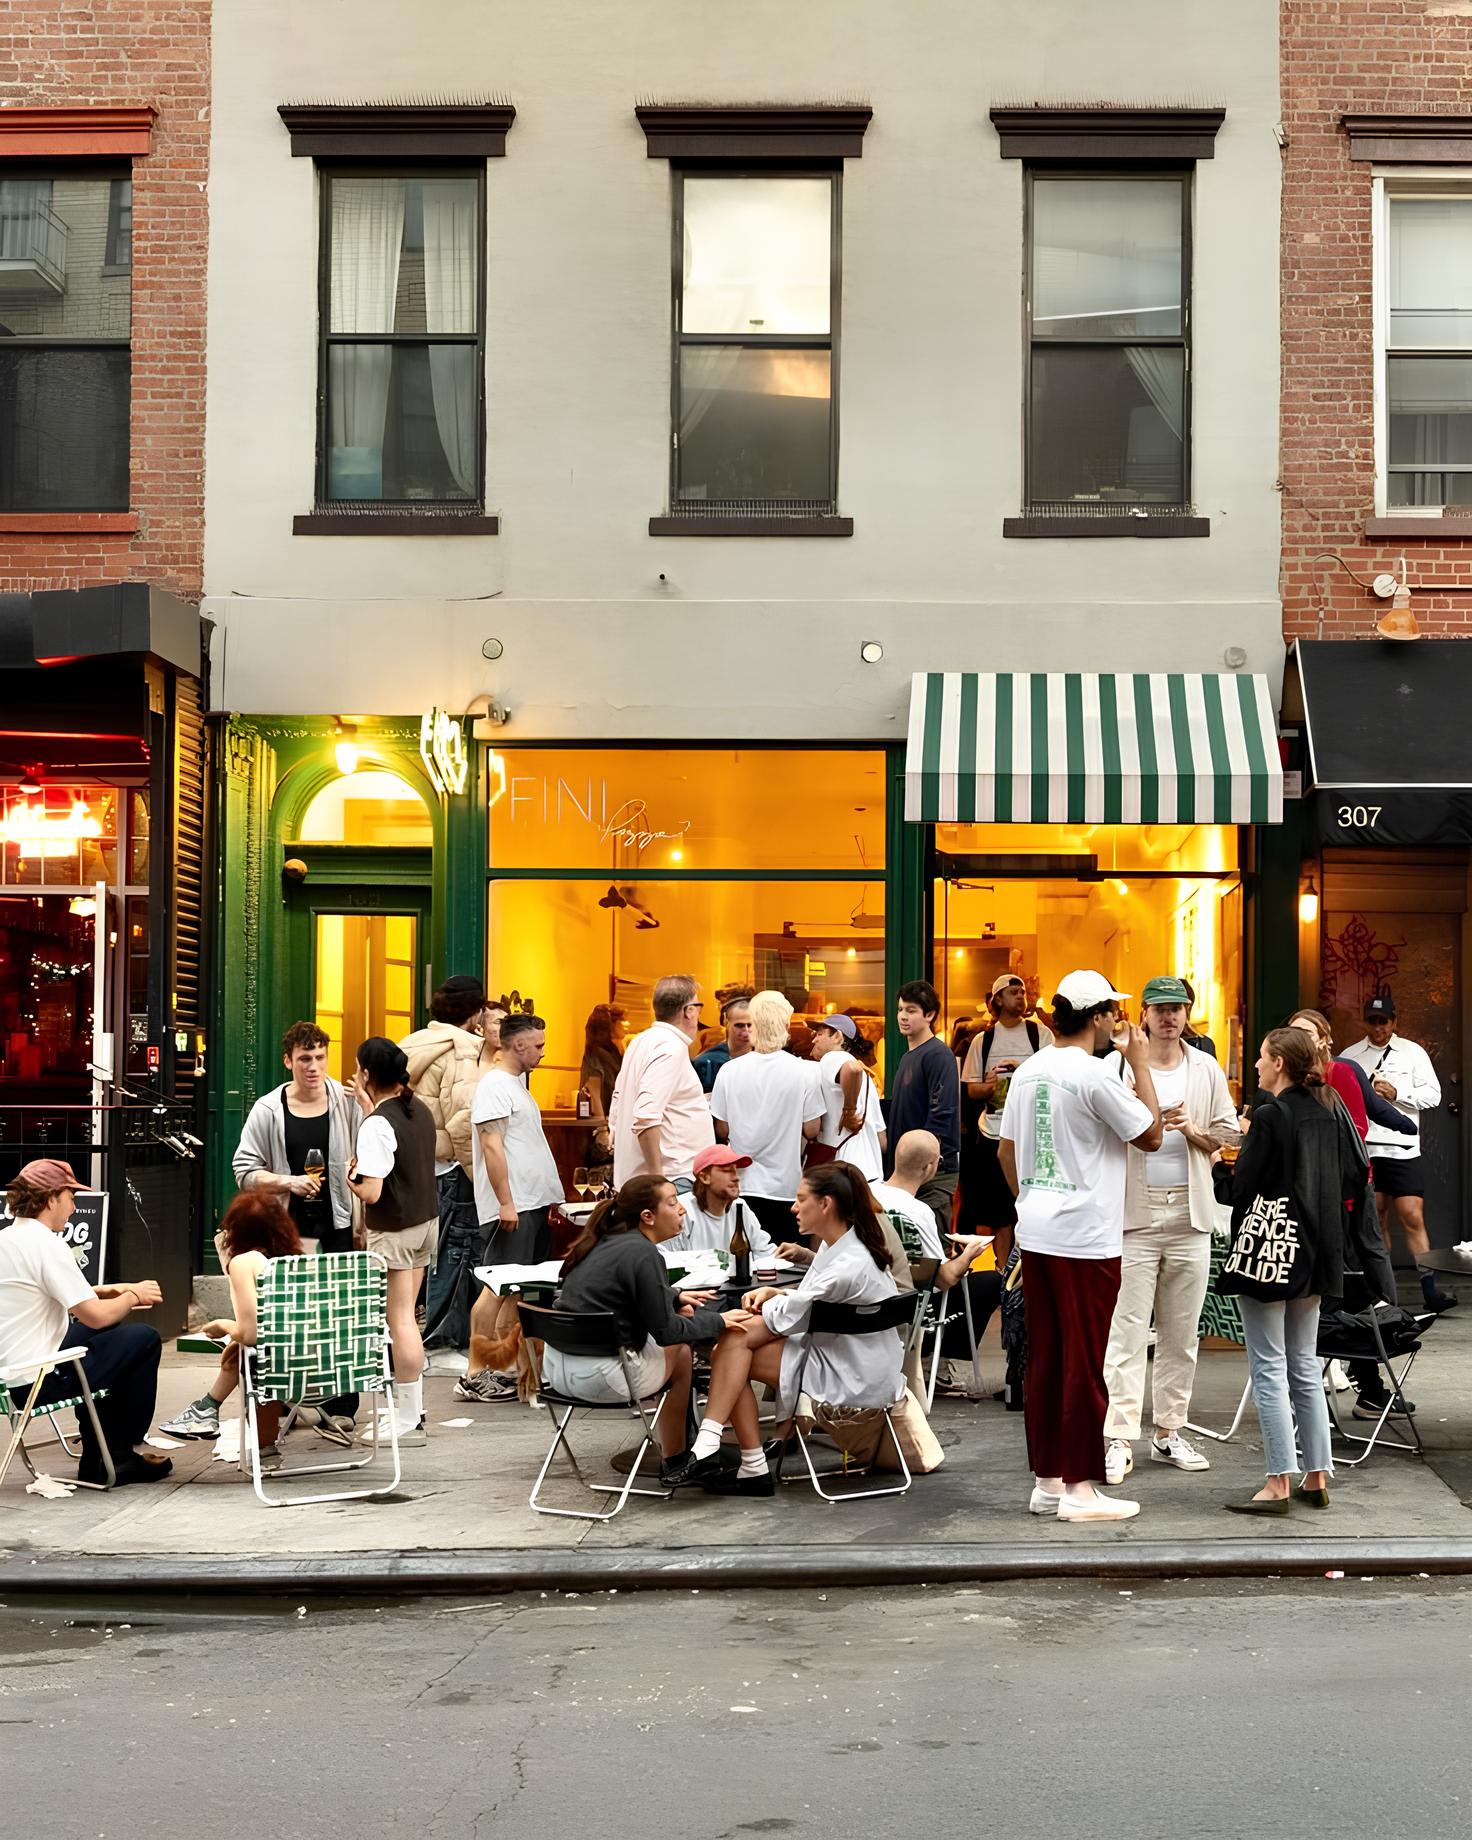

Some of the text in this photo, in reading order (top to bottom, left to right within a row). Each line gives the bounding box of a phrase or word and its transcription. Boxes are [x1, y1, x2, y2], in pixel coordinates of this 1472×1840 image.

[511, 775, 606, 825] FINI
[599, 798, 691, 849] Pizza
[1337, 805, 1382, 828] 307
[1256, 1240, 1301, 1264] ART
[1223, 1253, 1292, 1284] OLLIDE
